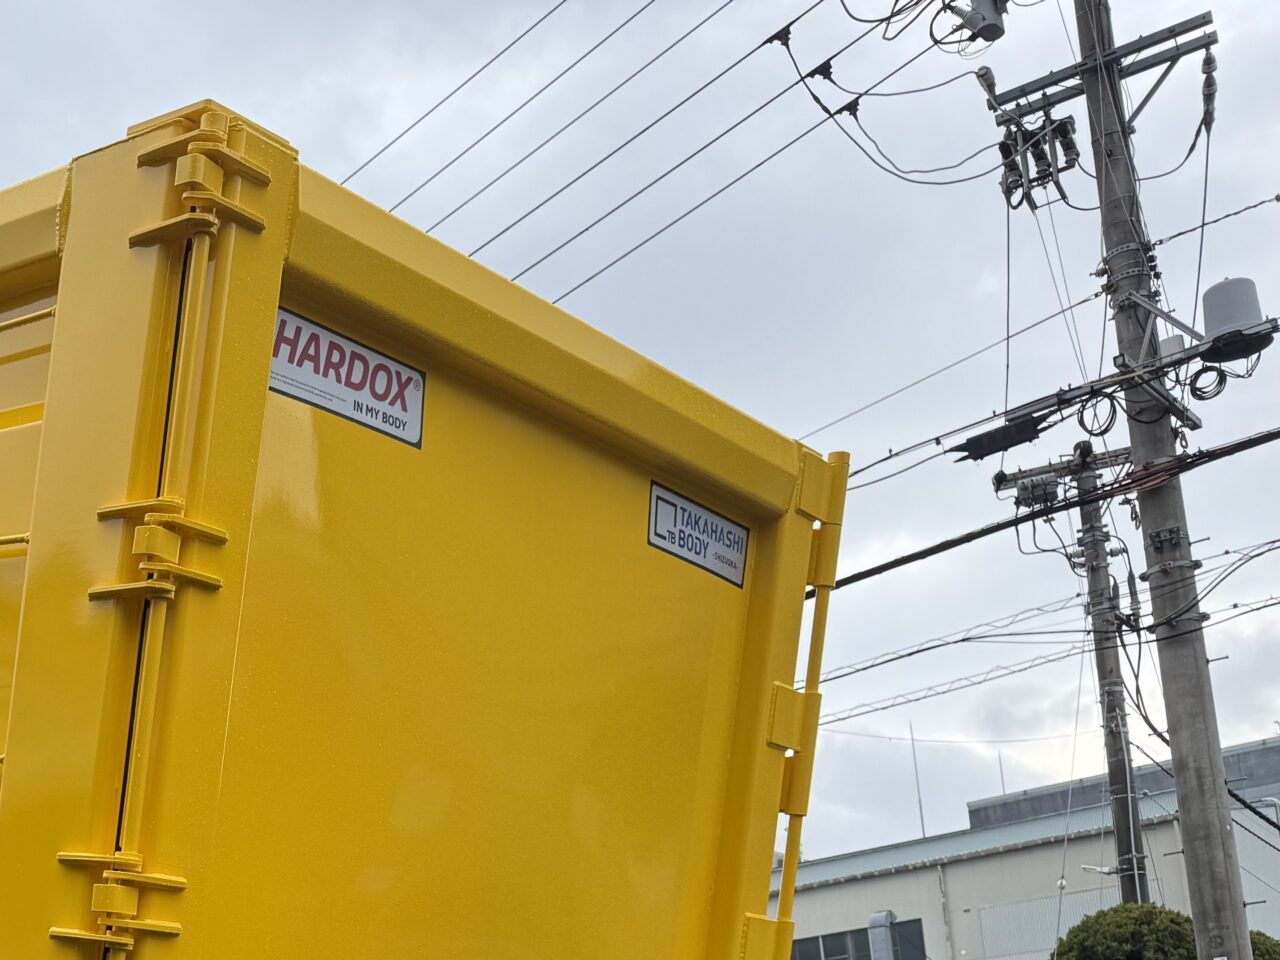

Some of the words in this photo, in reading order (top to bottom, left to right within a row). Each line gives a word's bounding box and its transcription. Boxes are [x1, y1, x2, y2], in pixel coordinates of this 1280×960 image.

[353, 399, 363, 415] IN
[365, 404, 380, 420] MY
[382, 411, 407, 431] BODY
[678, 528, 709, 559] BODY
[679, 506, 744, 556] TAKAHASHI
